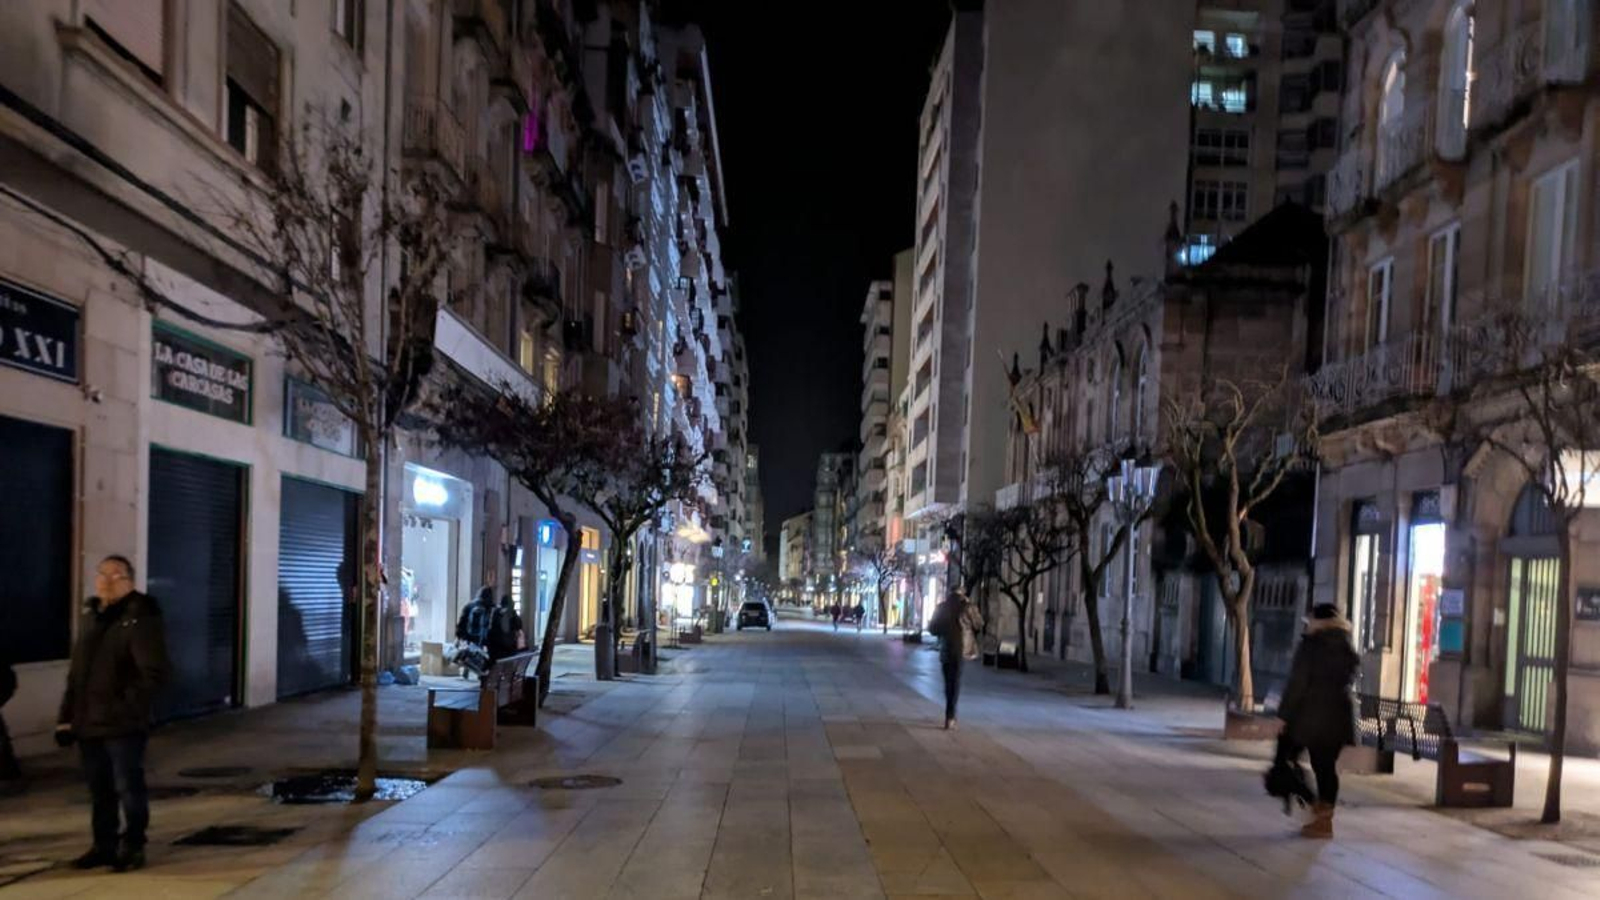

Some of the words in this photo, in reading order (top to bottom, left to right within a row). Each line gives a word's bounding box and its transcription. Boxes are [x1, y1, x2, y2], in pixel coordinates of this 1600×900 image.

[13, 327, 65, 368] XXI
[155, 342, 173, 364] LA
[176, 351, 209, 377] CASA
[209, 362, 226, 382] DE
[170, 370, 234, 405] CARCASAS
